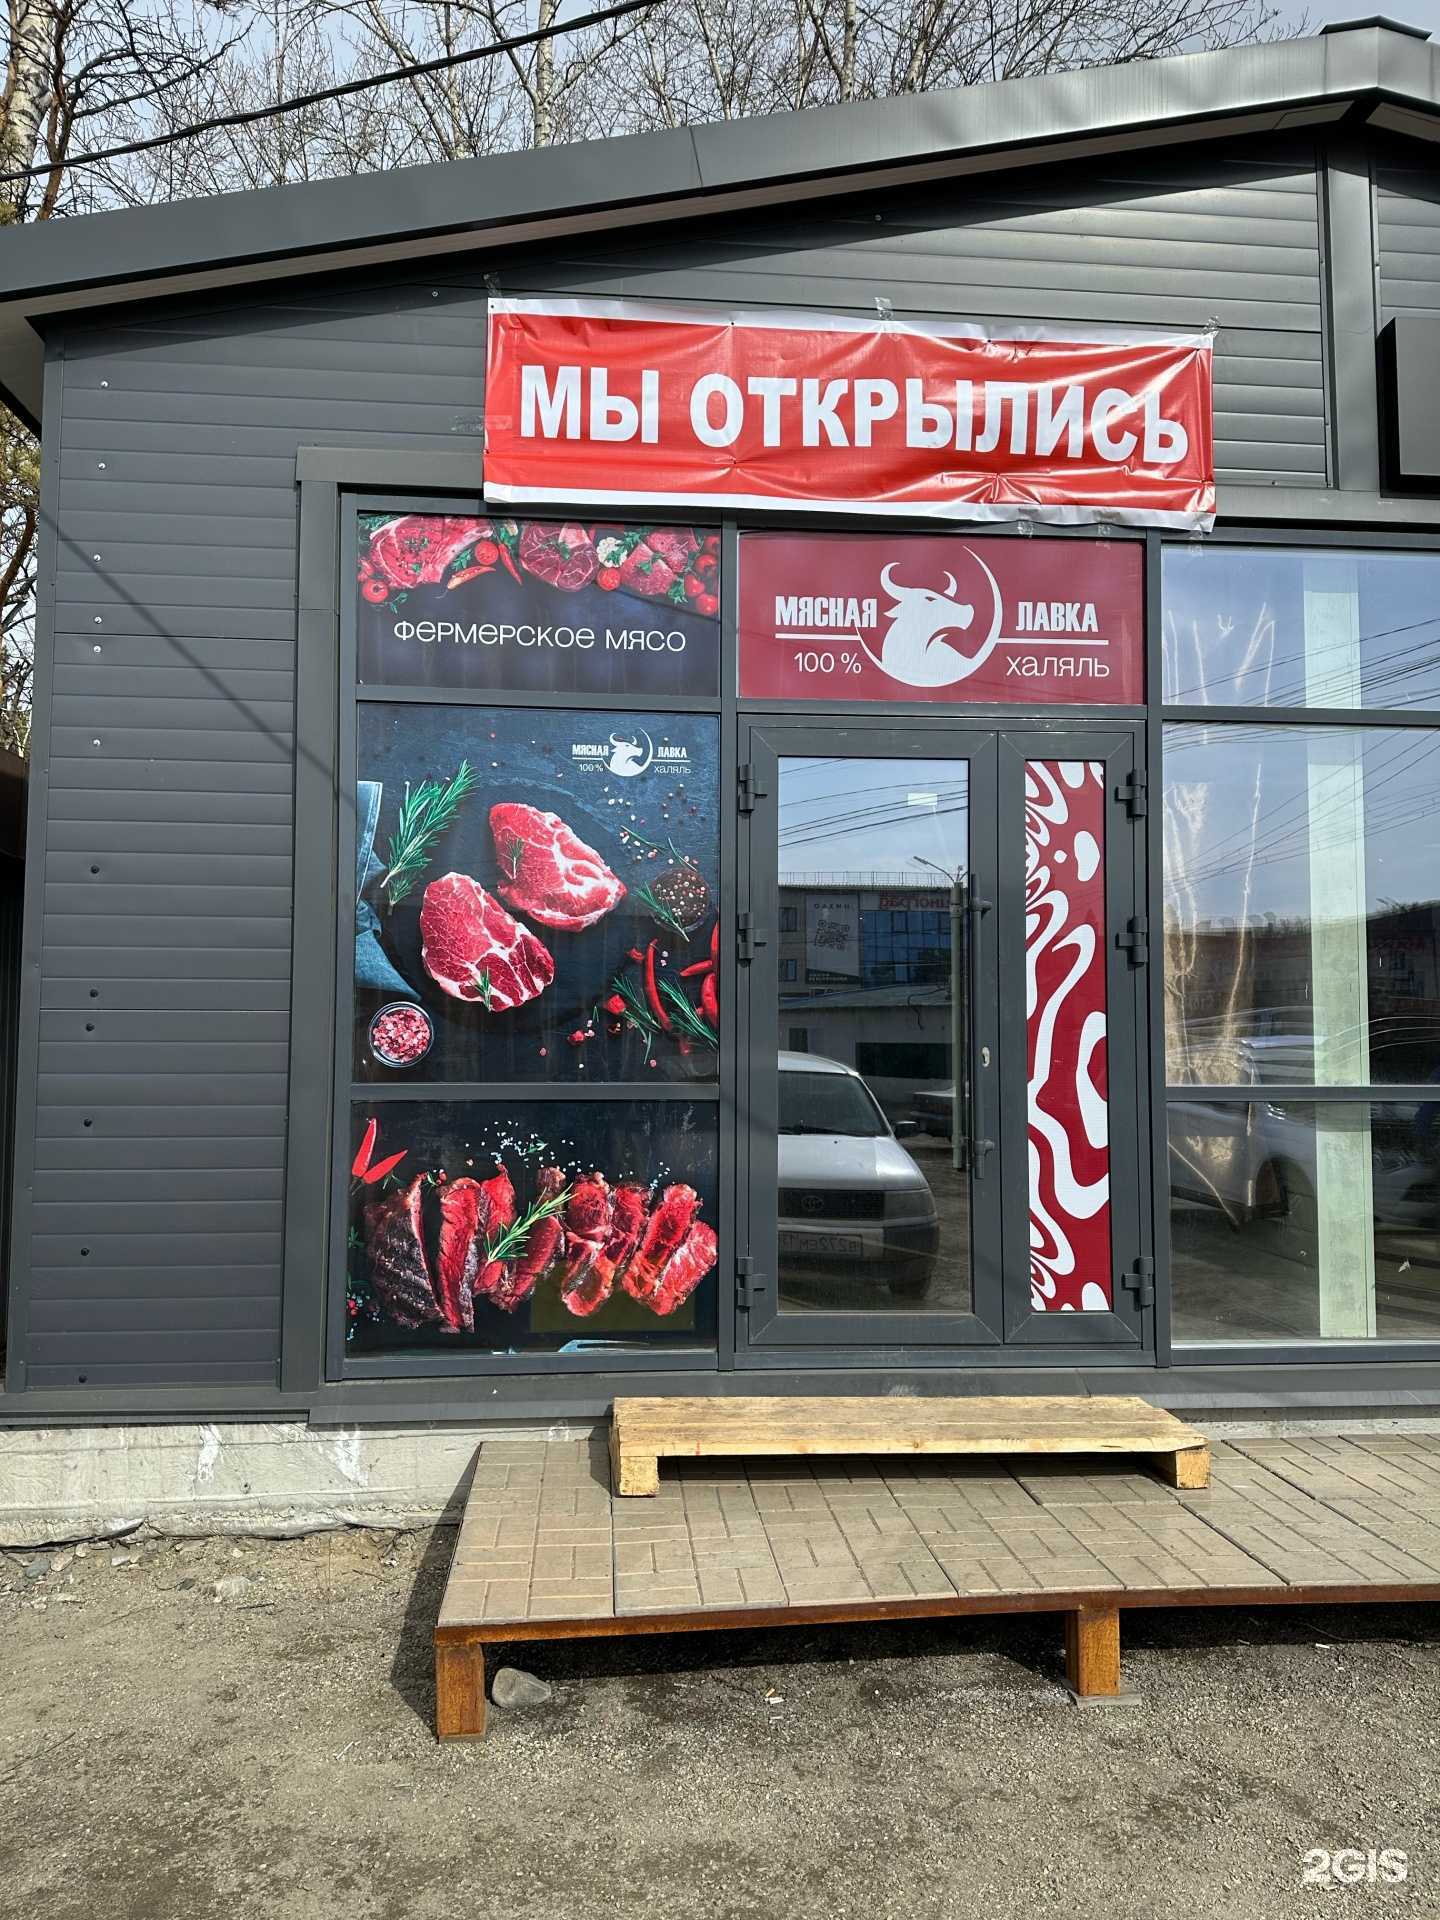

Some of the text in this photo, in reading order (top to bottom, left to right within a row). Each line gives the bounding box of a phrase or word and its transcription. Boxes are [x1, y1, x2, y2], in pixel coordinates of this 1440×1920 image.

[520, 365, 1190, 464] МЫ ОТКРЫЛИСЬ
[775, 595, 1099, 633] МЯСНАЯ ЛАВКА
[605, 628, 686, 652] МЯСО
[794, 652, 1110, 678] 100 % халяль
[572, 744, 688, 758] МЯСНАЯ ЛАВКА
[654, 765, 692, 775] халяль
